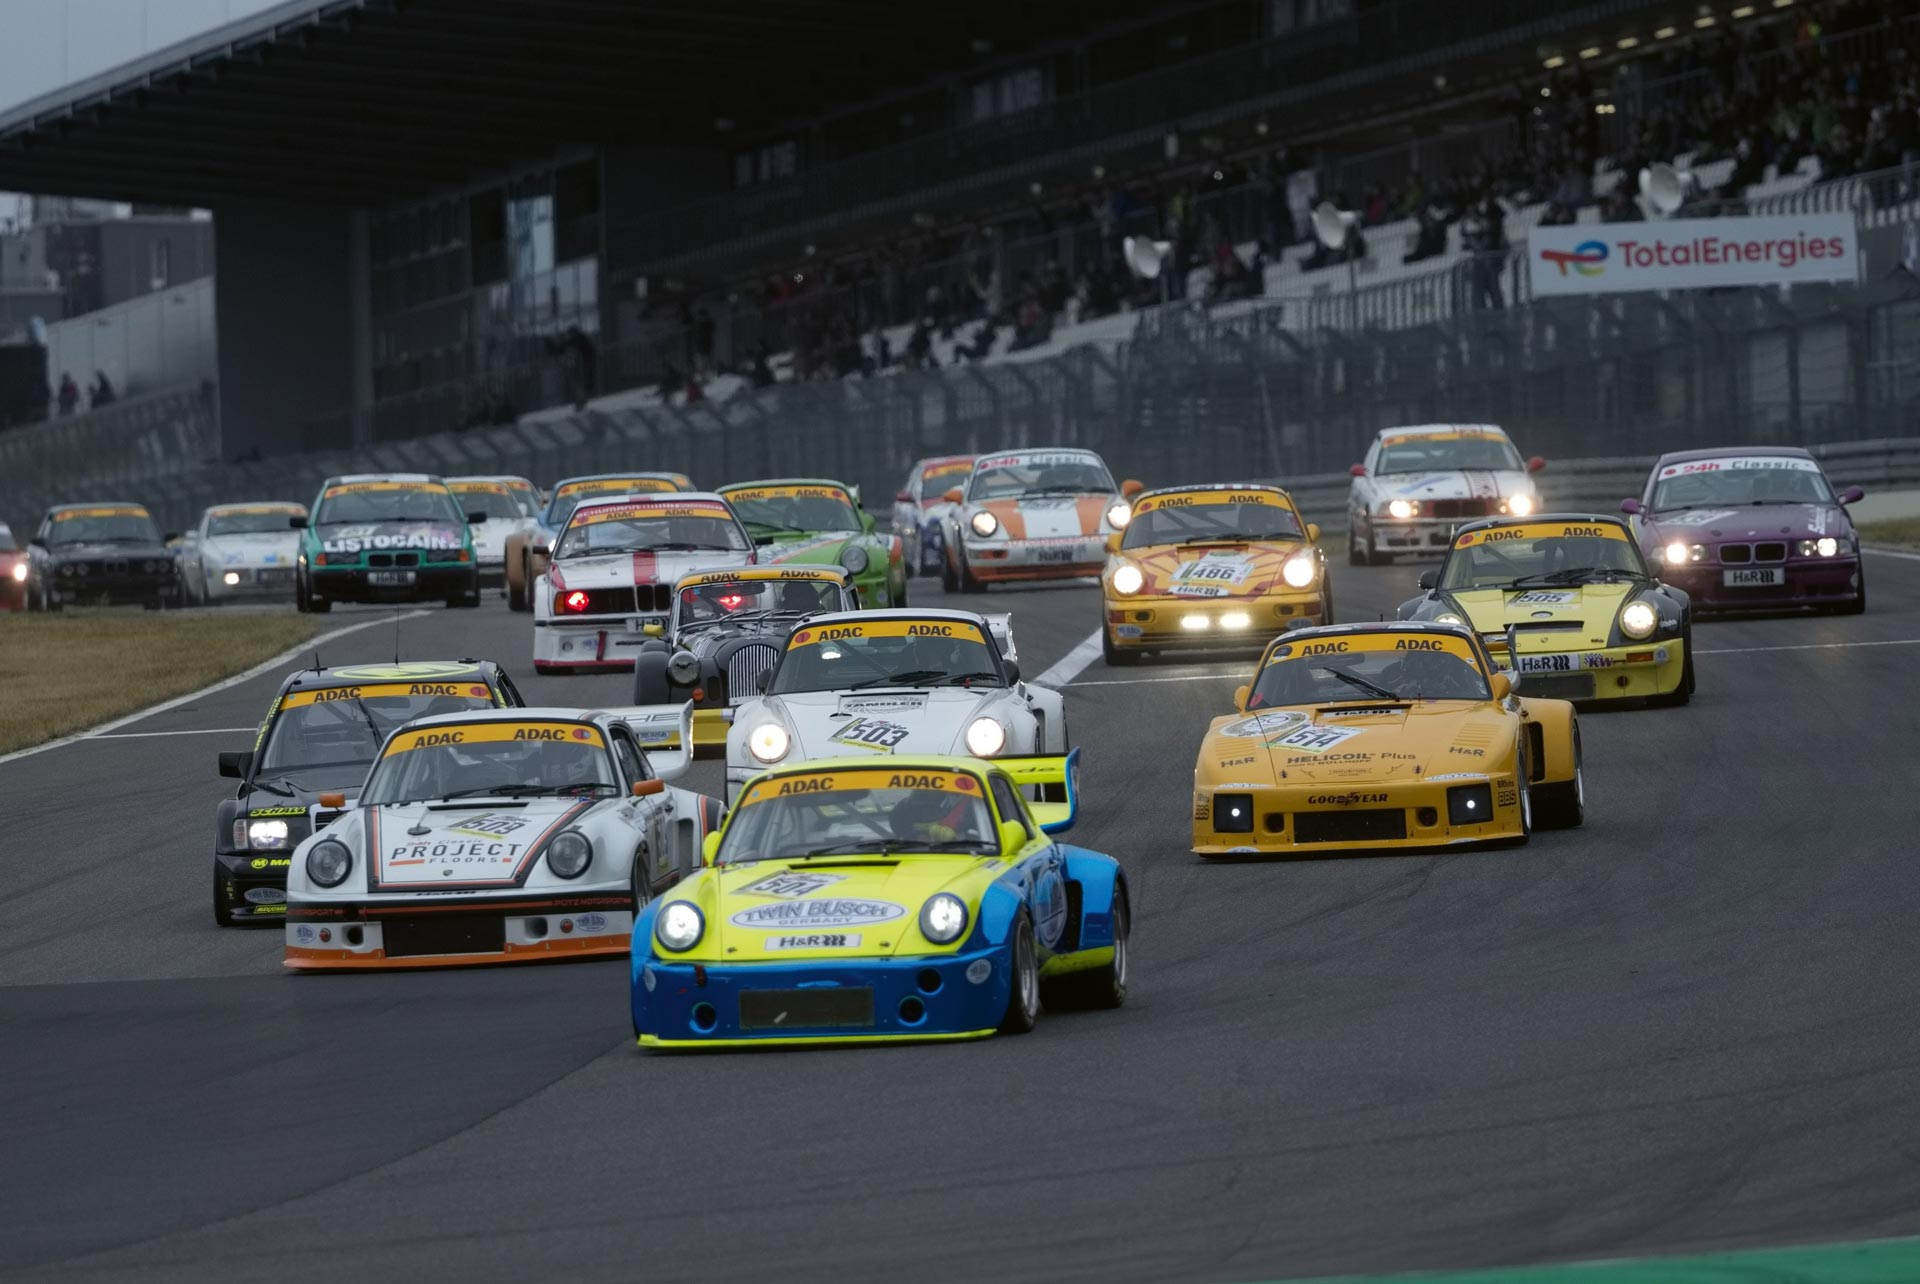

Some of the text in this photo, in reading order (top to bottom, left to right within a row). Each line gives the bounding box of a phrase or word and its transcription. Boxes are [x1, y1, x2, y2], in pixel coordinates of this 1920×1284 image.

[1617, 231, 1844, 268] TotalEnergies
[1682, 460, 1800, 474] 24h Classic
[734, 490, 765, 501] ADAC
[795, 489, 828, 498] ADAC
[1158, 495, 1265, 509] ADAC ADAC
[606, 508, 694, 521] ADAC ADAC
[1484, 527, 1603, 543] ADAC ADAC
[701, 570, 821, 583] ADAC ADAC
[1193, 567, 1236, 580] 486
[1733, 571, 1759, 584] H&R
[818, 625, 953, 642] ADAC ADAC
[1302, 639, 1443, 657] ADAC ADAC
[1522, 656, 1552, 673] H&R
[313, 684, 458, 703] ADAC ADAC
[413, 728, 567, 749] ADAC ADAC
[843, 723, 910, 747] 503
[1286, 731, 1344, 748] 514
[1381, 752, 1417, 760] Plus
[1449, 746, 1485, 757] H&R
[1221, 756, 1255, 768] H&R
[778, 775, 945, 796] ADAC ADAC
[1498, 790, 1517, 807] BBS
[461, 818, 526, 836] 509
[391, 843, 523, 861] PROJECT
[744, 899, 888, 922] TWIN BUSCH
[778, 916, 853, 926] GERMANY
[779, 935, 820, 948] H&R
